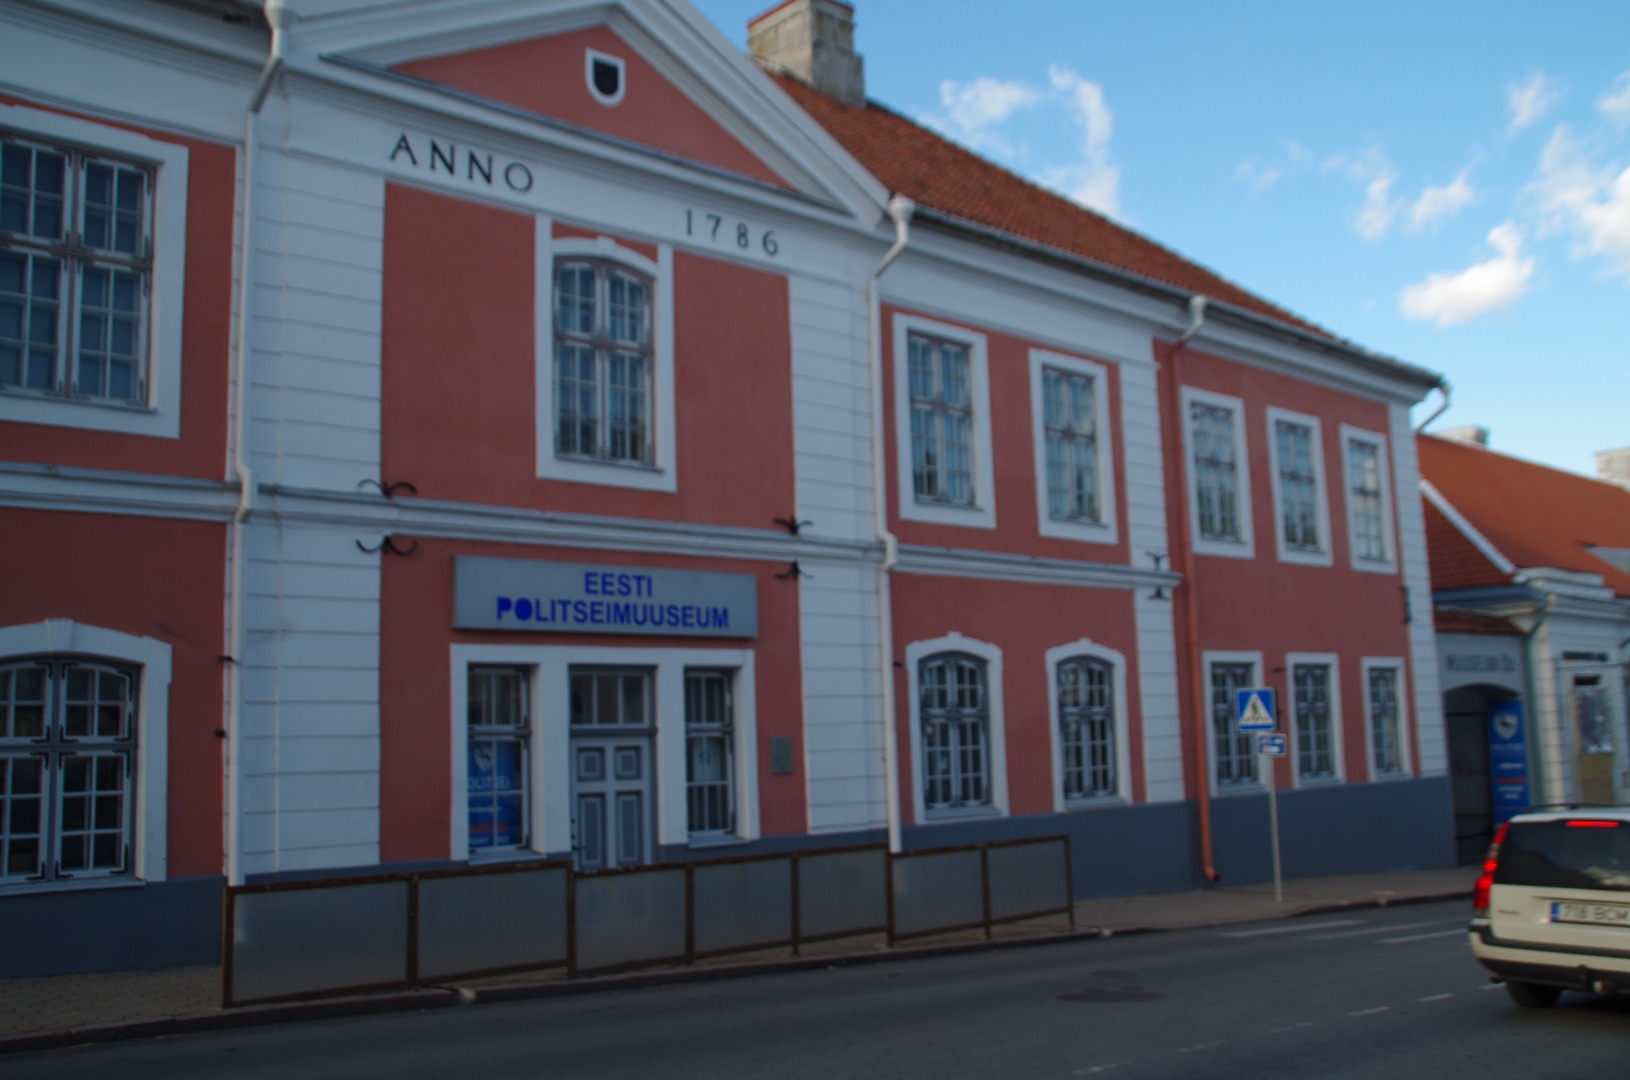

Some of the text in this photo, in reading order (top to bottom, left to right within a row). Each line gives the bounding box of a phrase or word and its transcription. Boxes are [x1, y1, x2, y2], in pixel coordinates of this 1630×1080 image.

[389, 133, 779, 256] ANNO 1786
[584, 571, 653, 597] EESTI
[496, 596, 729, 629] POLITSEIMUUSEUM
